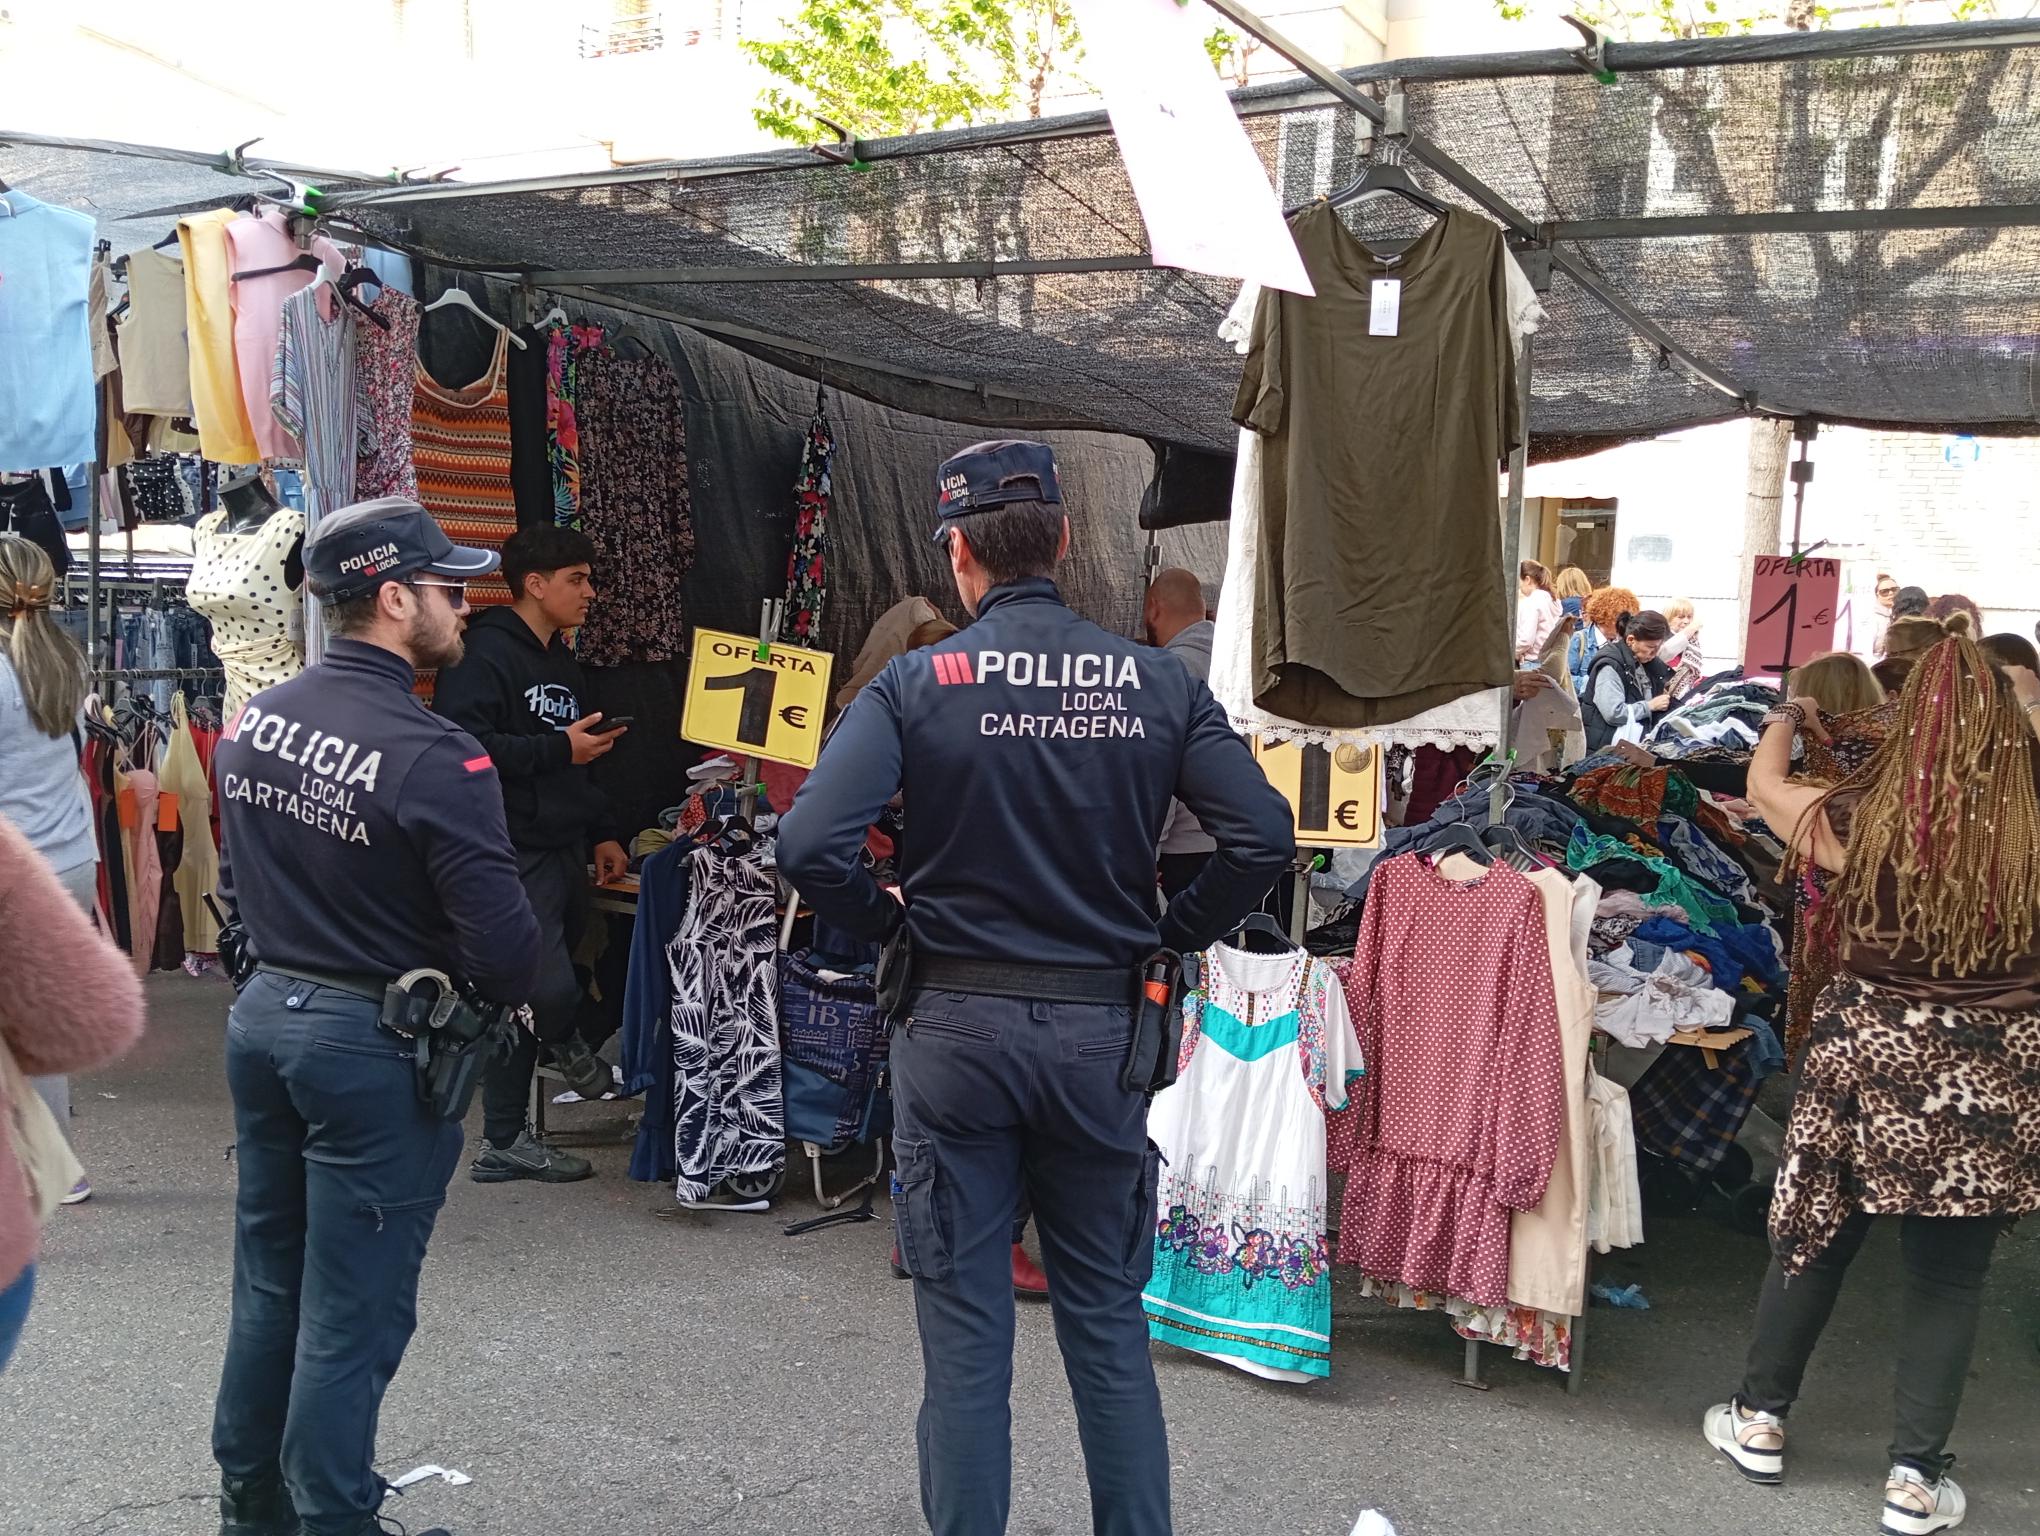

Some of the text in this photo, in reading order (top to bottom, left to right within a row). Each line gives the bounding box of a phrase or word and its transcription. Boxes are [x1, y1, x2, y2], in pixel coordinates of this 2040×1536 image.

[949, 487, 970, 501] LOCAL
[339, 542, 399, 575] POLICIA
[376, 556, 401, 573] LOCAL
[1755, 557, 1836, 578] OFERTA
[712, 643, 816, 675] OFERTA
[976, 650, 1142, 690] POLICIA
[1062, 692, 1128, 712] LOCAL
[980, 713, 1146, 739] CARTAGENA
[233, 707, 383, 793] POLICIA
[224, 773, 371, 846] CARTAGENA
[300, 773, 357, 815] LOCAL
